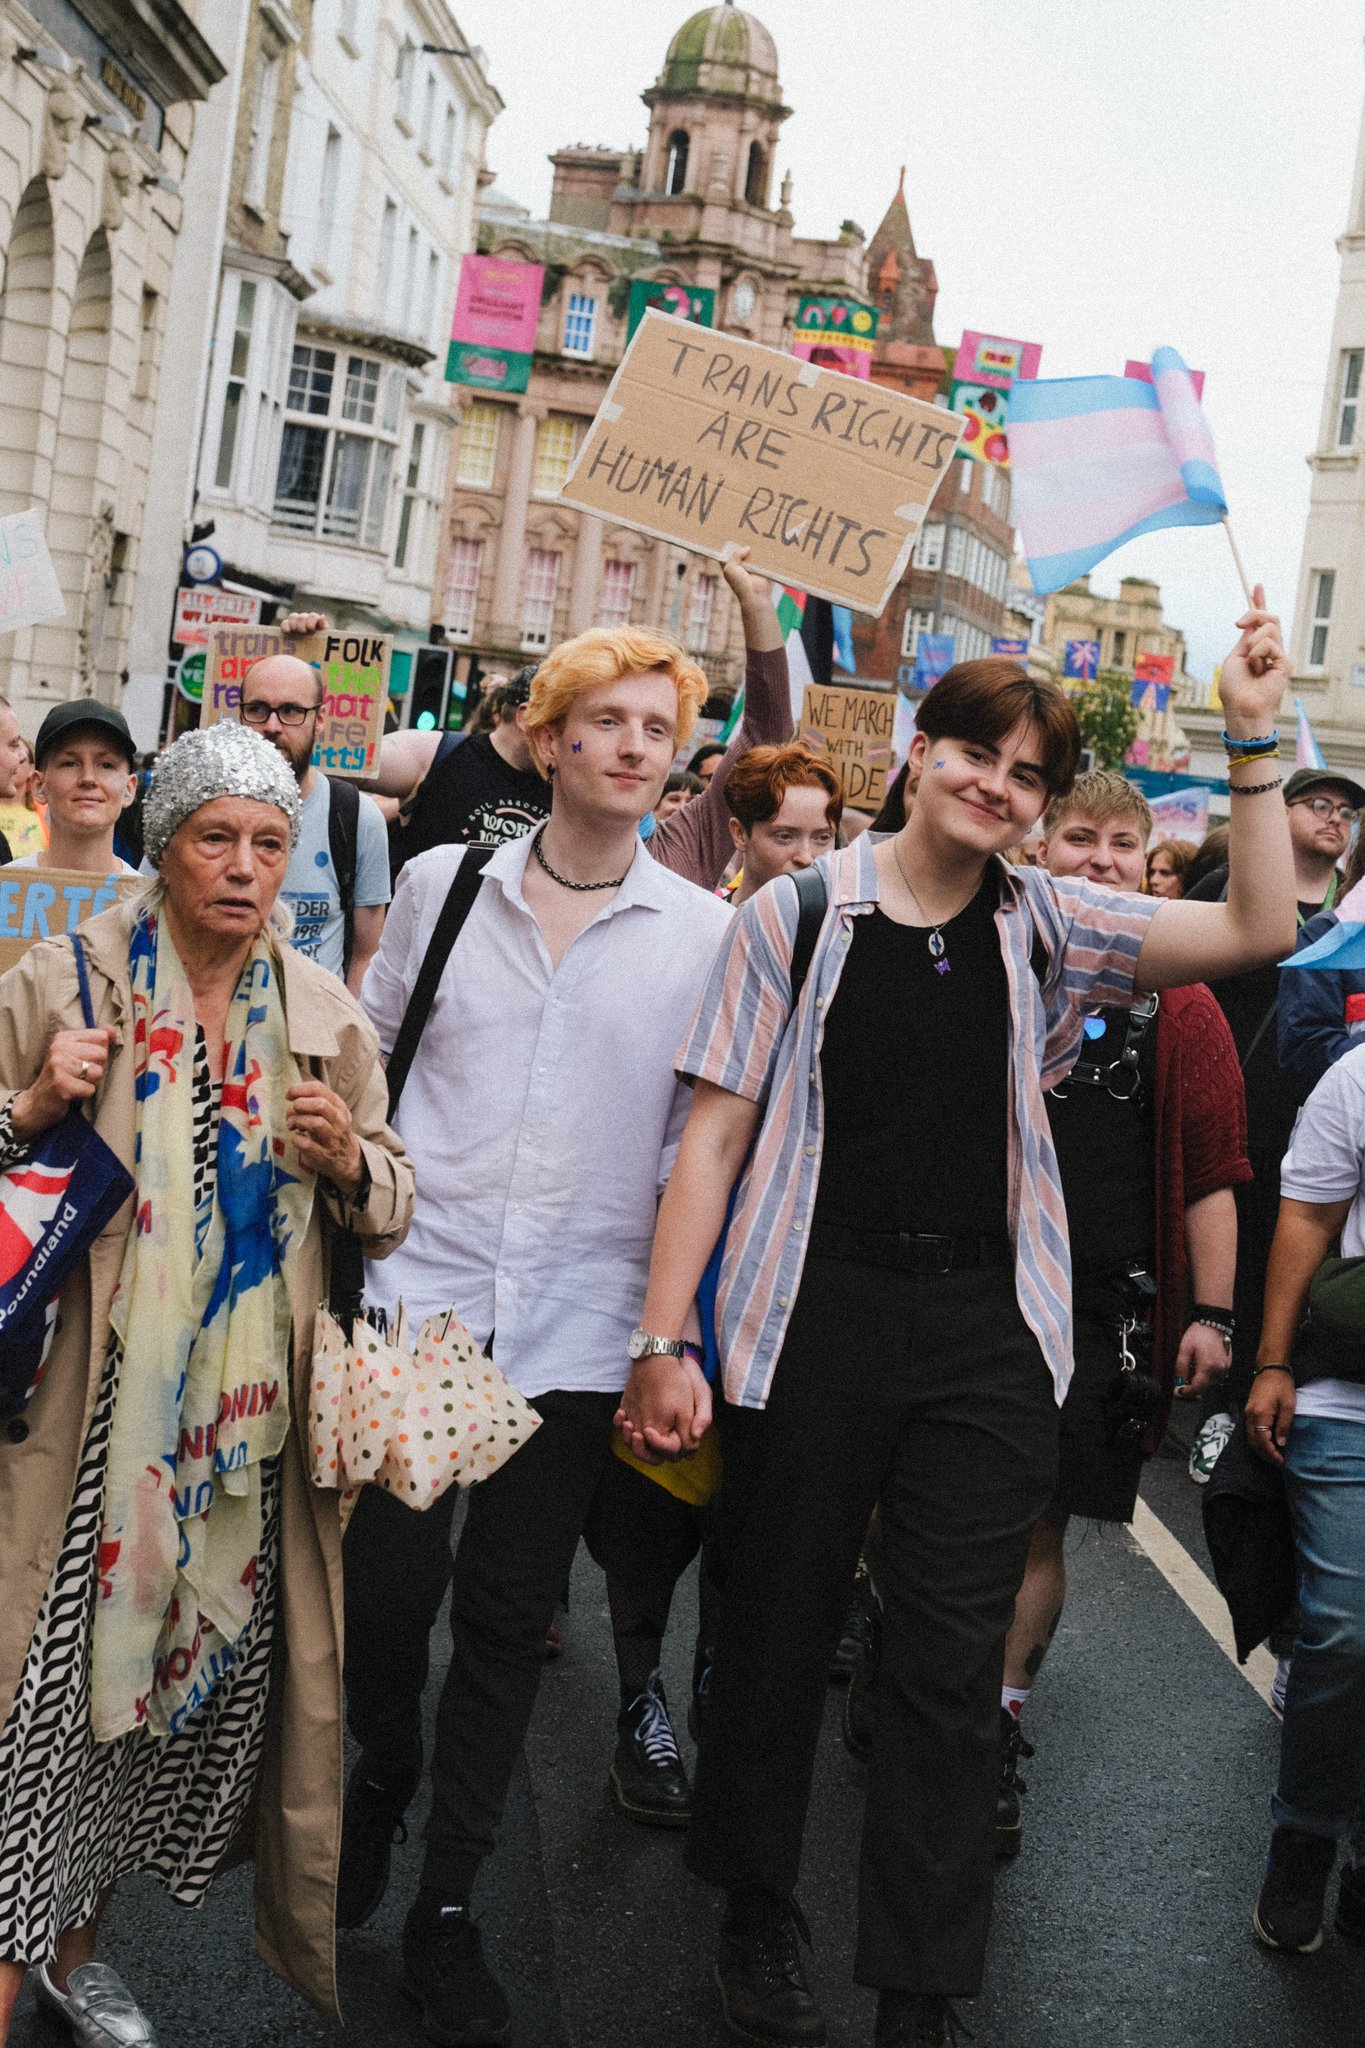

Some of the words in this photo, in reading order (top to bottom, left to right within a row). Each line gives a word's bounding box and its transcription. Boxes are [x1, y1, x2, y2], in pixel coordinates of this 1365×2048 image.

[667, 337, 807, 416] TRANS
[811, 391, 960, 470] RIGHTS
[697, 411, 792, 470] ARE
[588, 437, 725, 525] HUMAN
[738, 487, 886, 577] RIGHTS
[214, 630, 297, 655] trans
[324, 636, 384, 667] FOLK
[327, 661, 381, 694] the
[322, 685, 375, 721] hat
[808, 691, 841, 728] WE
[842, 696, 895, 737] MARCH
[310, 743, 376, 771] itty!
[826, 738, 865, 758] WITH
[840, 761, 885, 801] IDE
[468, 802, 493, 821] SOIL
[482, 813, 535, 837] WOR
